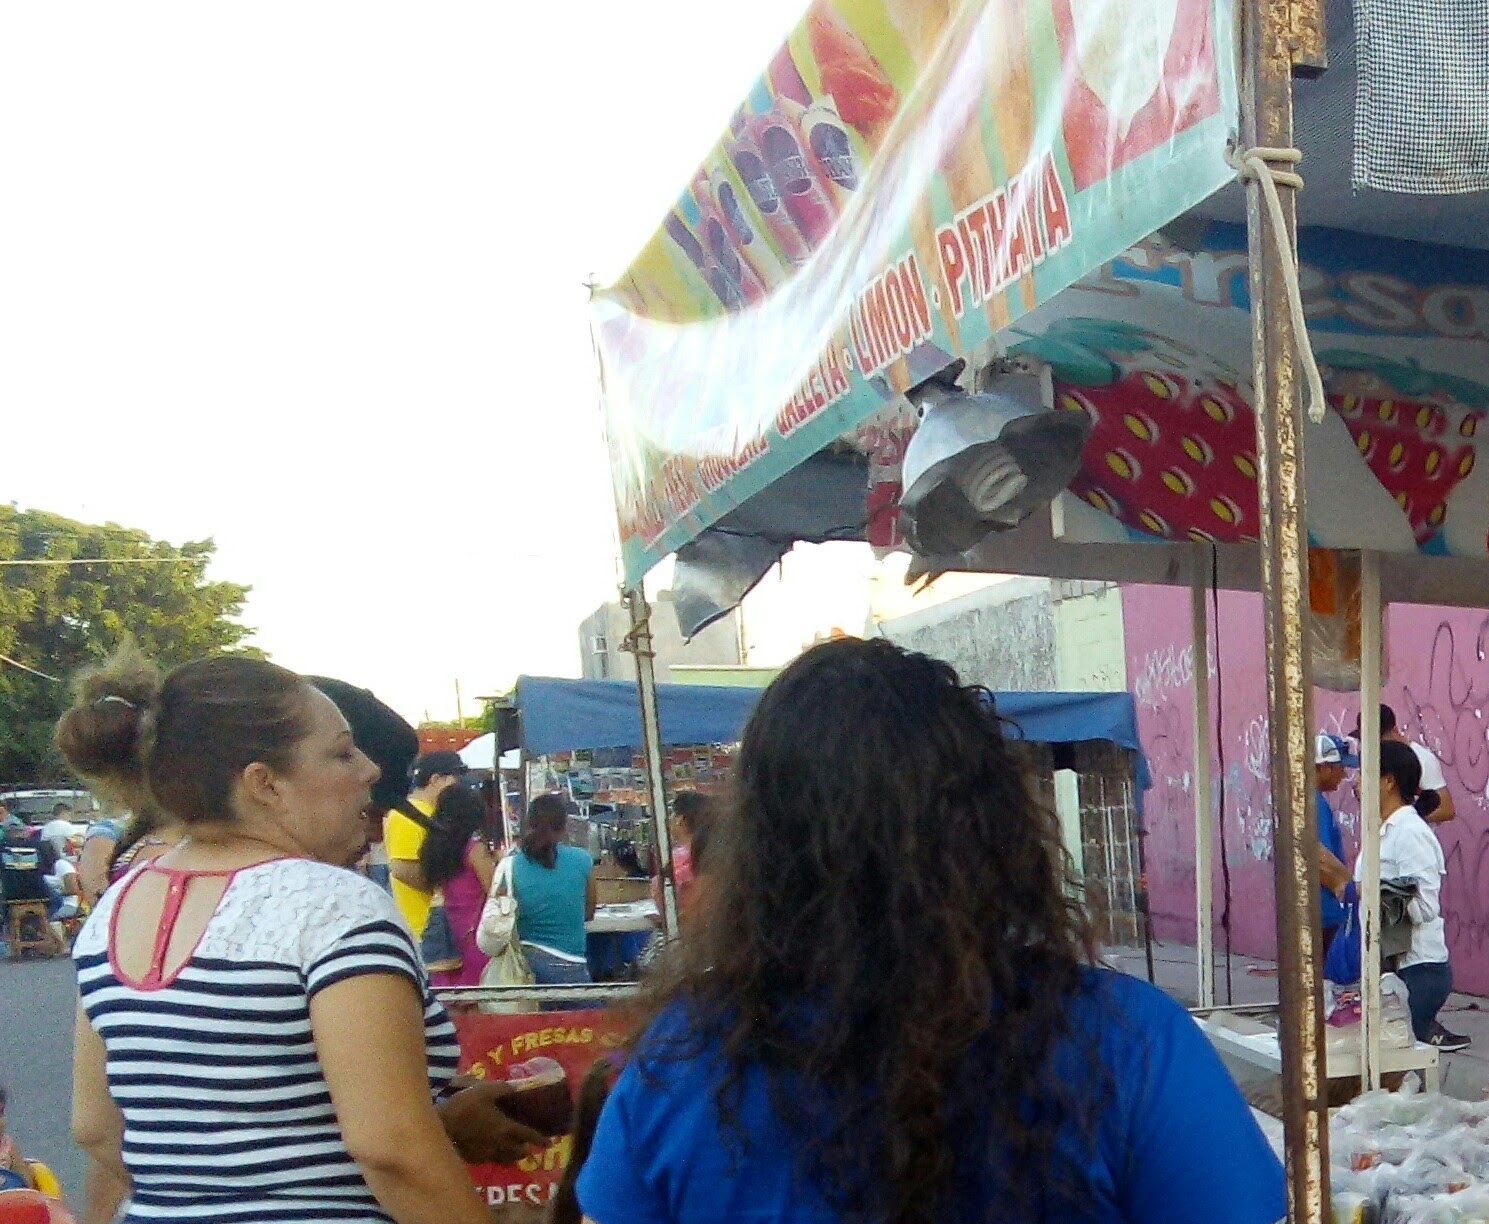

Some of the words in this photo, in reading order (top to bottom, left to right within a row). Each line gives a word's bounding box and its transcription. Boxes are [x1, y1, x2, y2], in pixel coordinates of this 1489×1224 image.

[850, 251, 933, 380] LIMON
[936, 150, 1073, 319] PITHAYA
[511, 1027, 594, 1056] FRESAS
